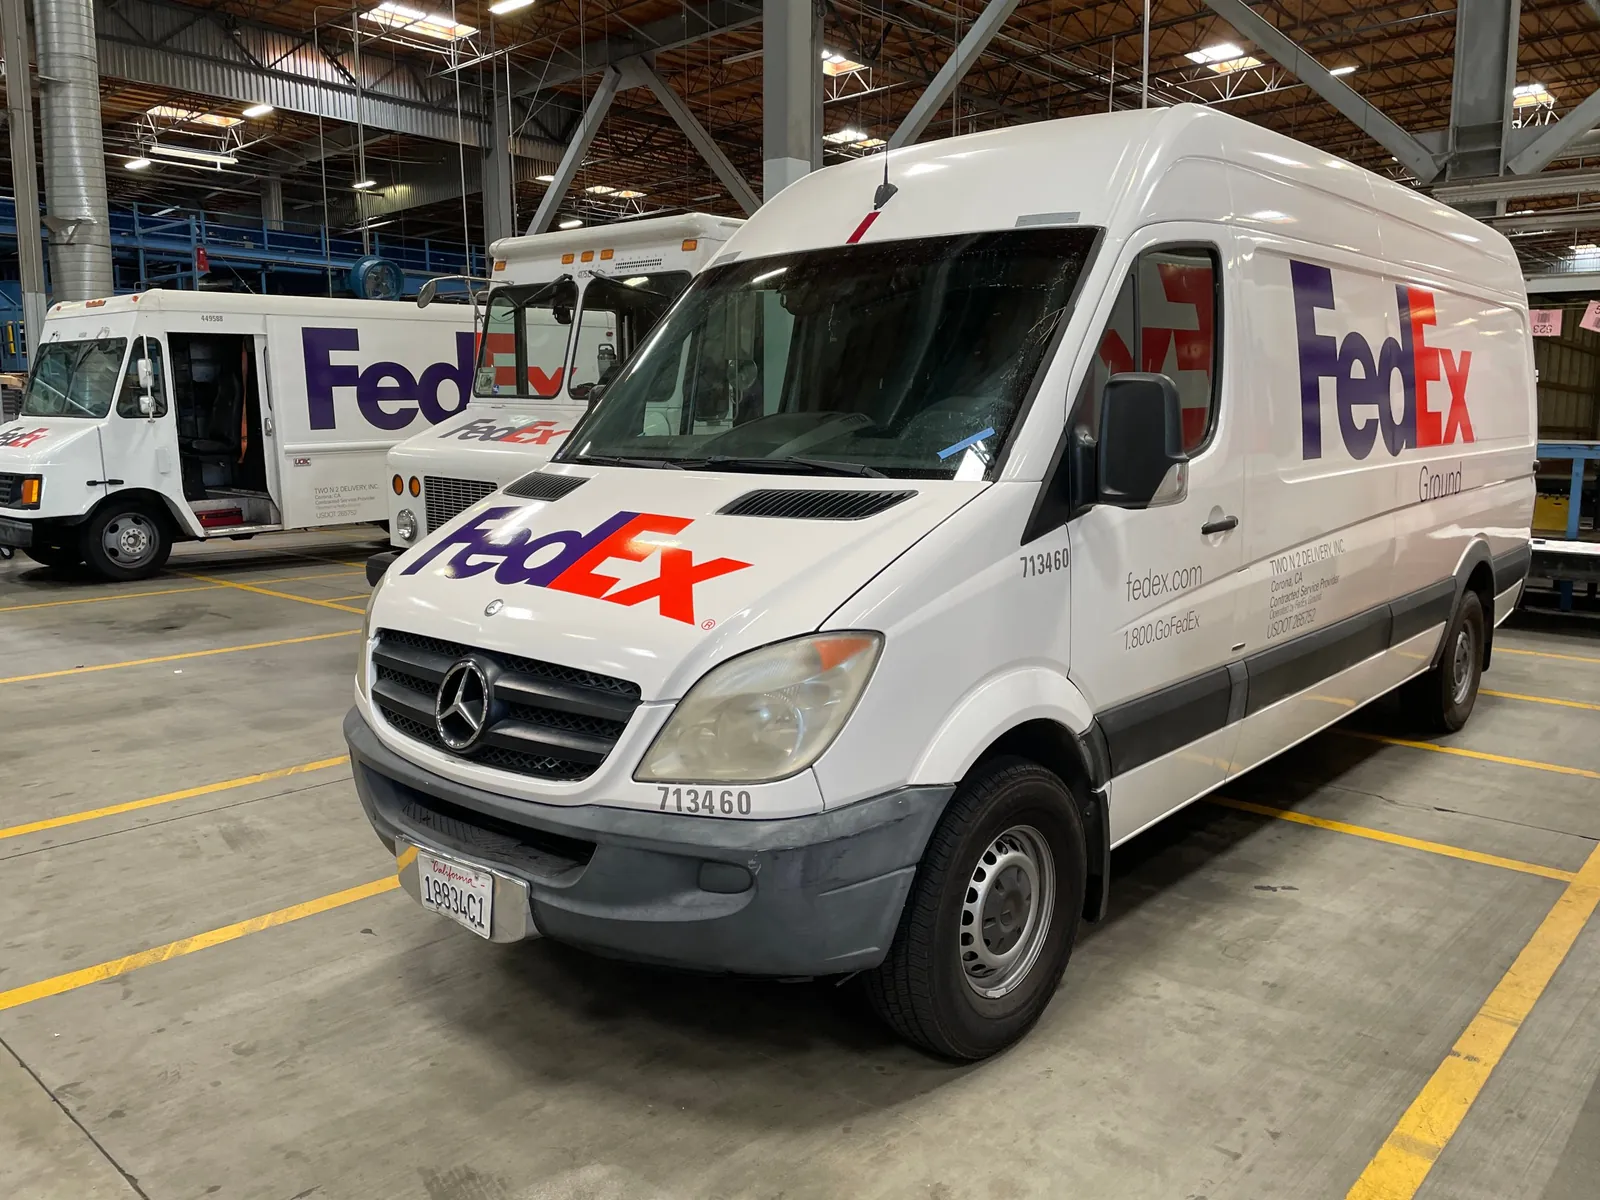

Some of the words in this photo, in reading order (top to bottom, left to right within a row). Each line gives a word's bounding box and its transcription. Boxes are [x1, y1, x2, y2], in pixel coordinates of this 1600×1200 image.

[1290, 259, 1475, 460] FedEx
[438, 419, 571, 445] FedEx
[1419, 462, 1462, 502] Ground
[316, 511, 336, 519] USDOT
[400, 507, 754, 626] FedEx
[1020, 547, 1069, 578] 713460
[1270, 556, 1288, 576] TWO
[1289, 554, 1296, 570] N
[1296, 551, 1302, 567] 2
[1126, 565, 1203, 602] fedex.com
[1270, 589, 1300, 608] Contracted
[1300, 581, 1319, 597] Service
[1320, 574, 1340, 589] Provider
[1294, 572, 1303, 585] CA
[1123, 610, 1201, 651] 1.800.GoFedEx
[1267, 615, 1293, 639] USDOT
[657, 786, 751, 815] 713460
[432, 860, 477, 888] California
[425, 875, 485, 929] 18834C1
